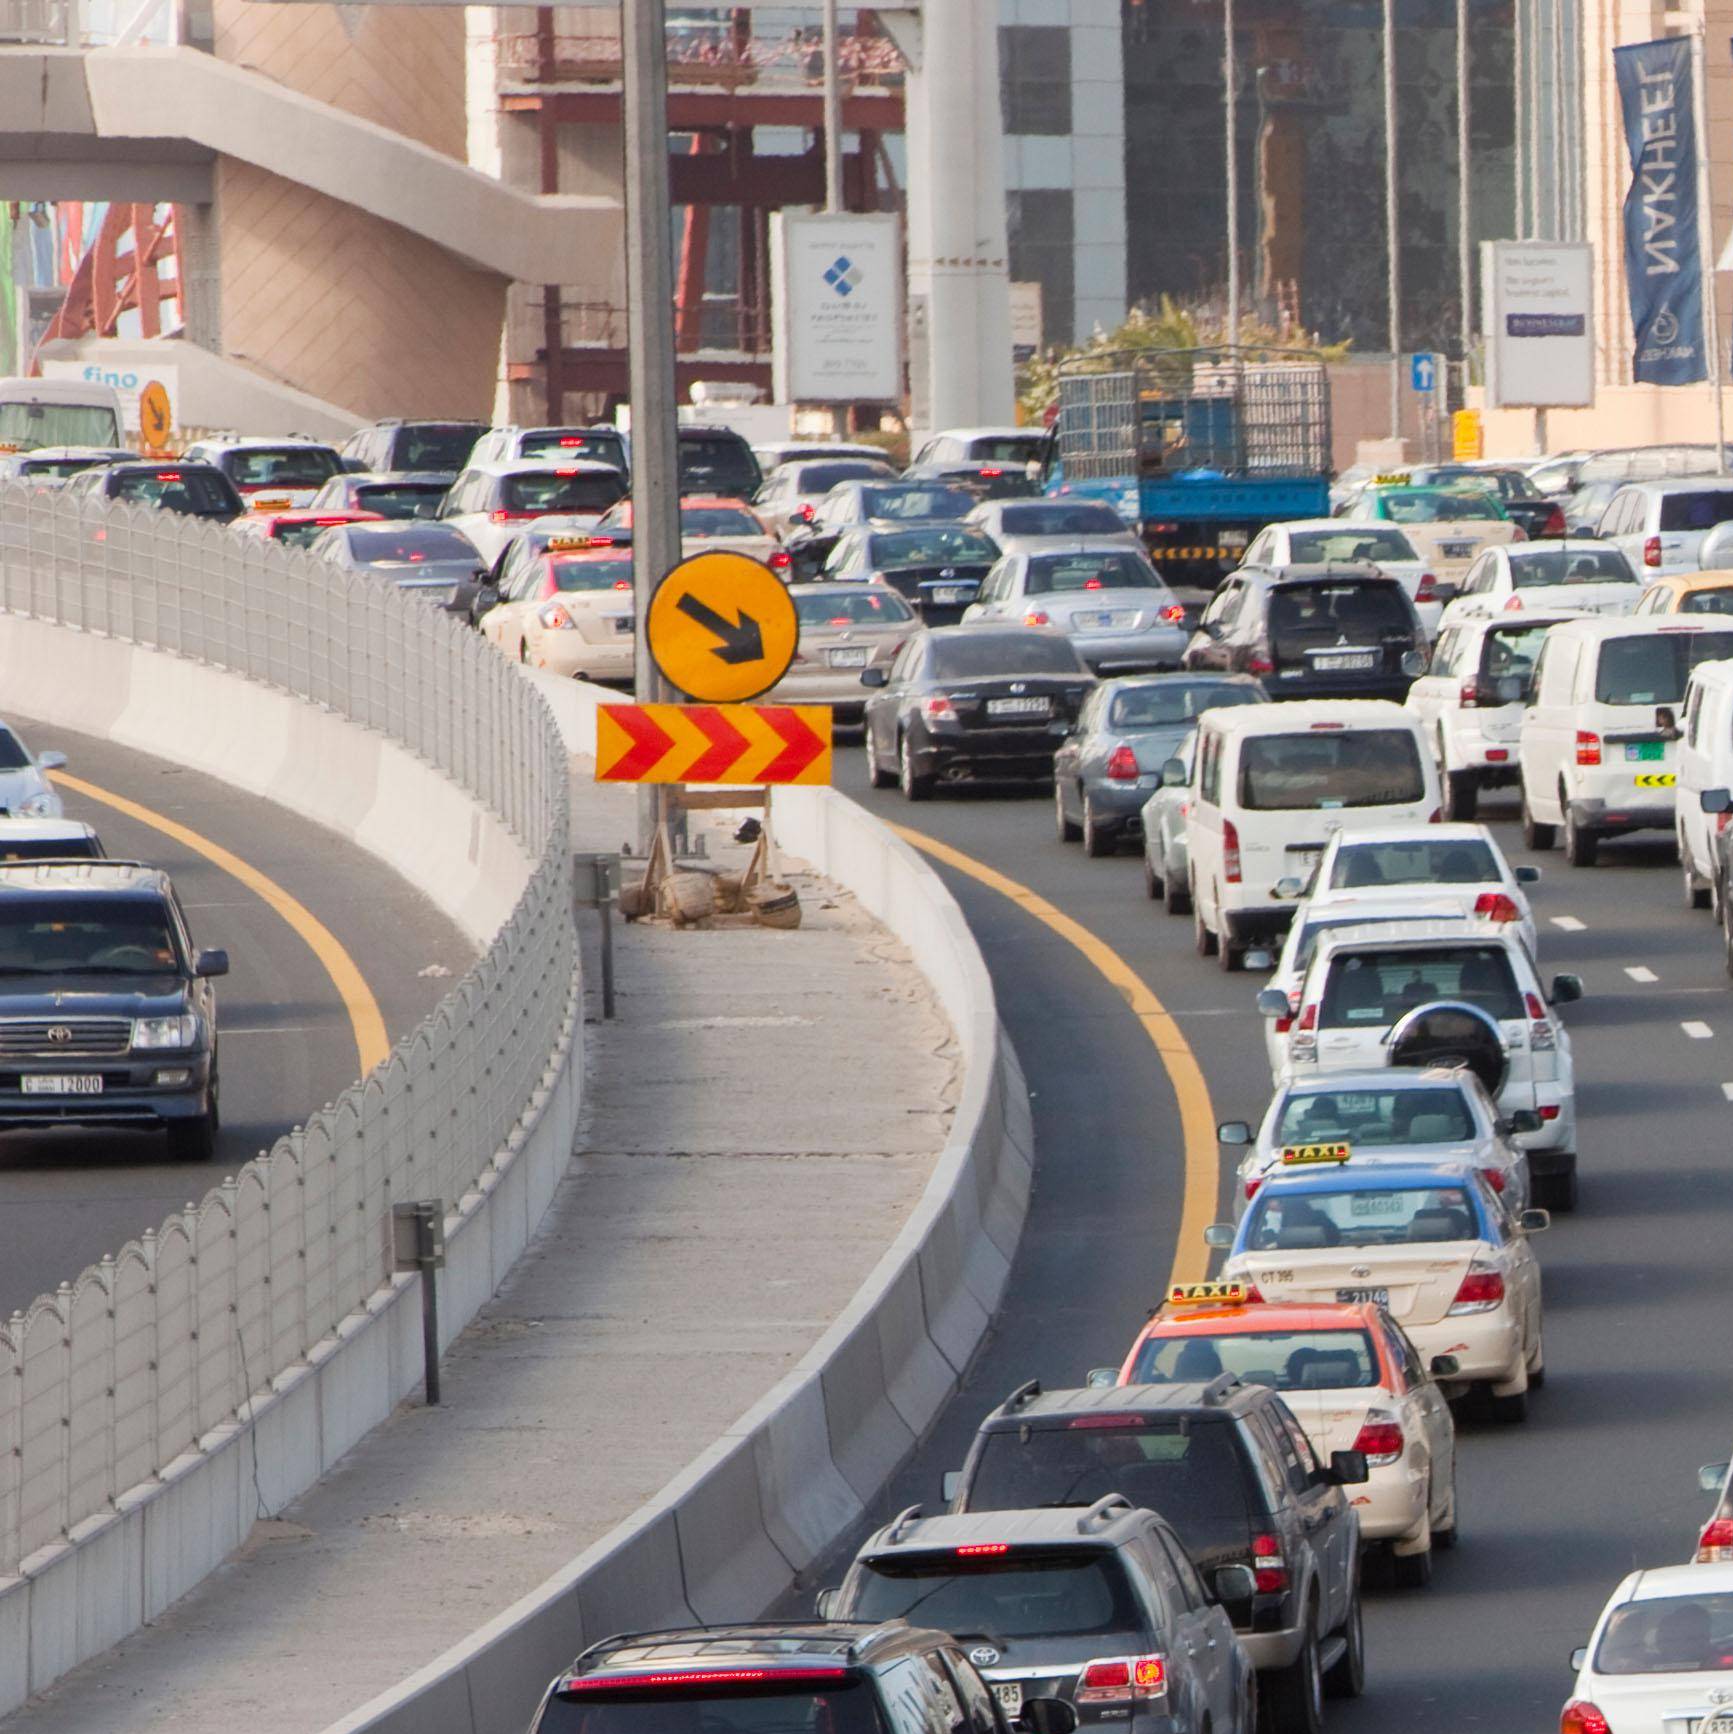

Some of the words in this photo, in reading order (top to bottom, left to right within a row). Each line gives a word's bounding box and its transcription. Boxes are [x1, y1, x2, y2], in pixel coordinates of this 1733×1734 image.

[84, 366, 138, 388] fino
[1294, 1145, 1338, 1158] TAXI
[1186, 1284, 1232, 1299] TAXI
